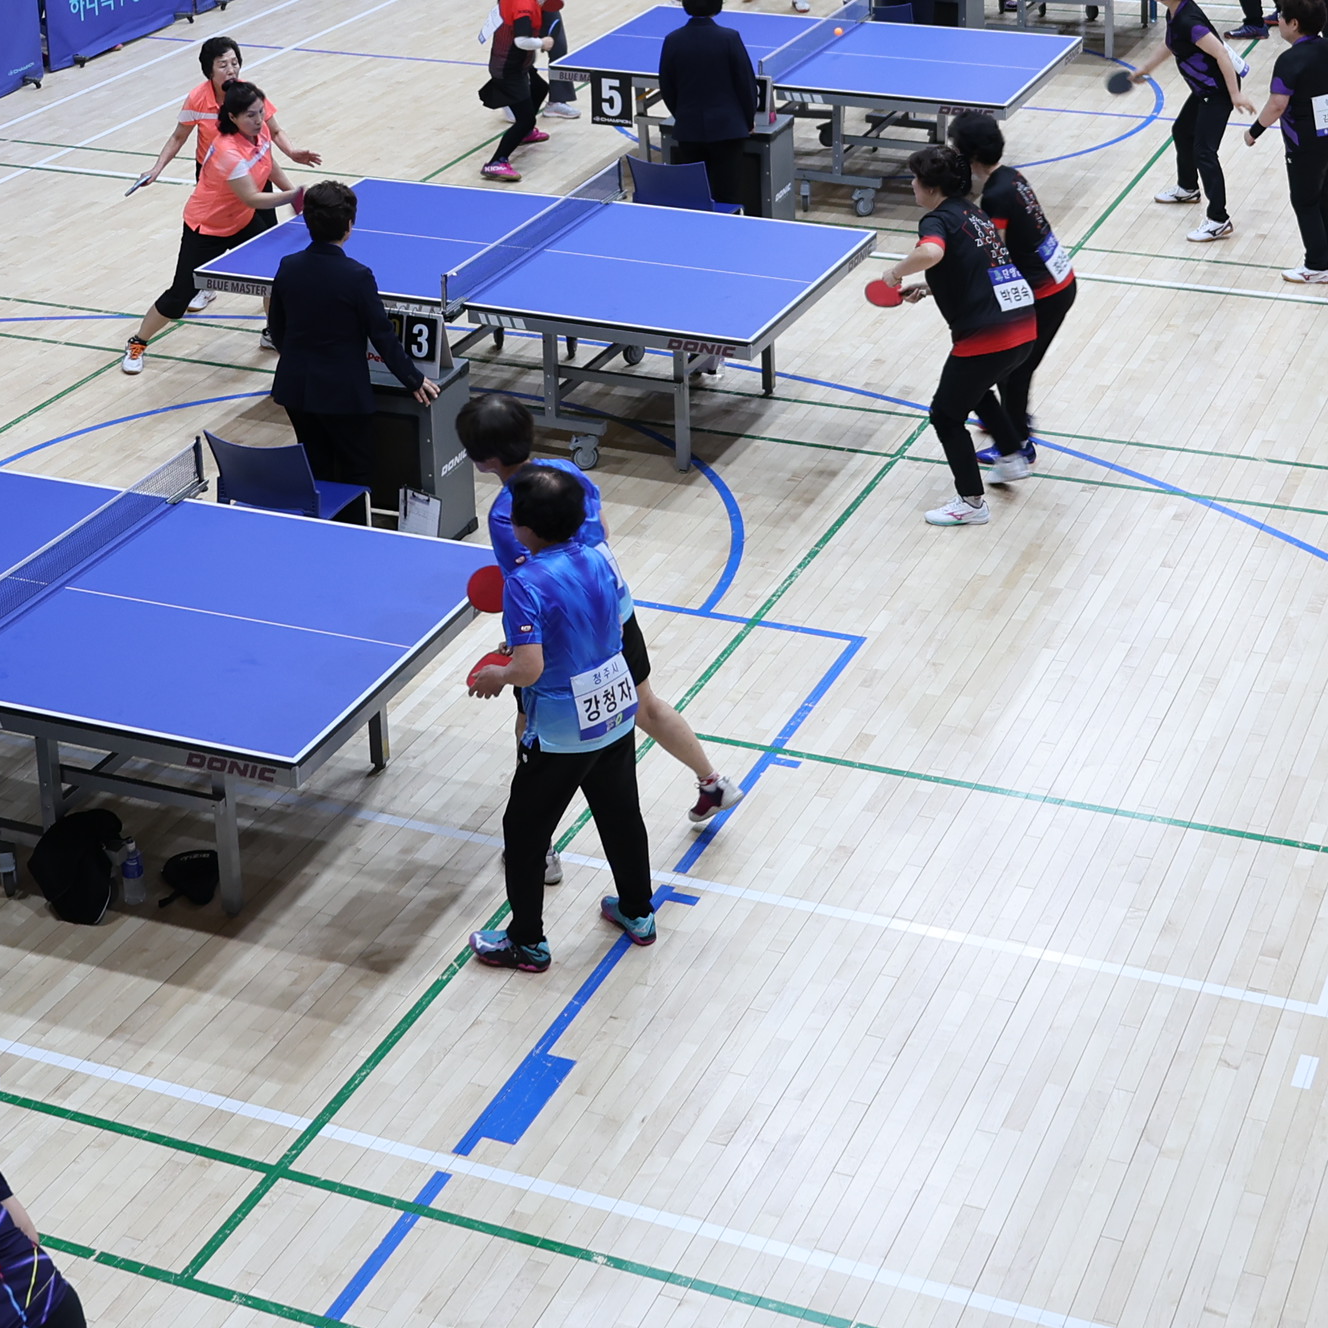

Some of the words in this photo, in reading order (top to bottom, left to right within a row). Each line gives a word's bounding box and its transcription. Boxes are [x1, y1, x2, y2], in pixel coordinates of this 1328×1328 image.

[559, 72, 578, 81] BLUE
[600, 77, 622, 117] 5
[206, 278, 229, 292] BLUE
[230, 281, 268, 297] MASTER
[410, 323, 429, 359] 3
[667, 338, 736, 358] DONIC
[583, 676, 633, 722] 강청자
[185, 752, 277, 783] DONIC
